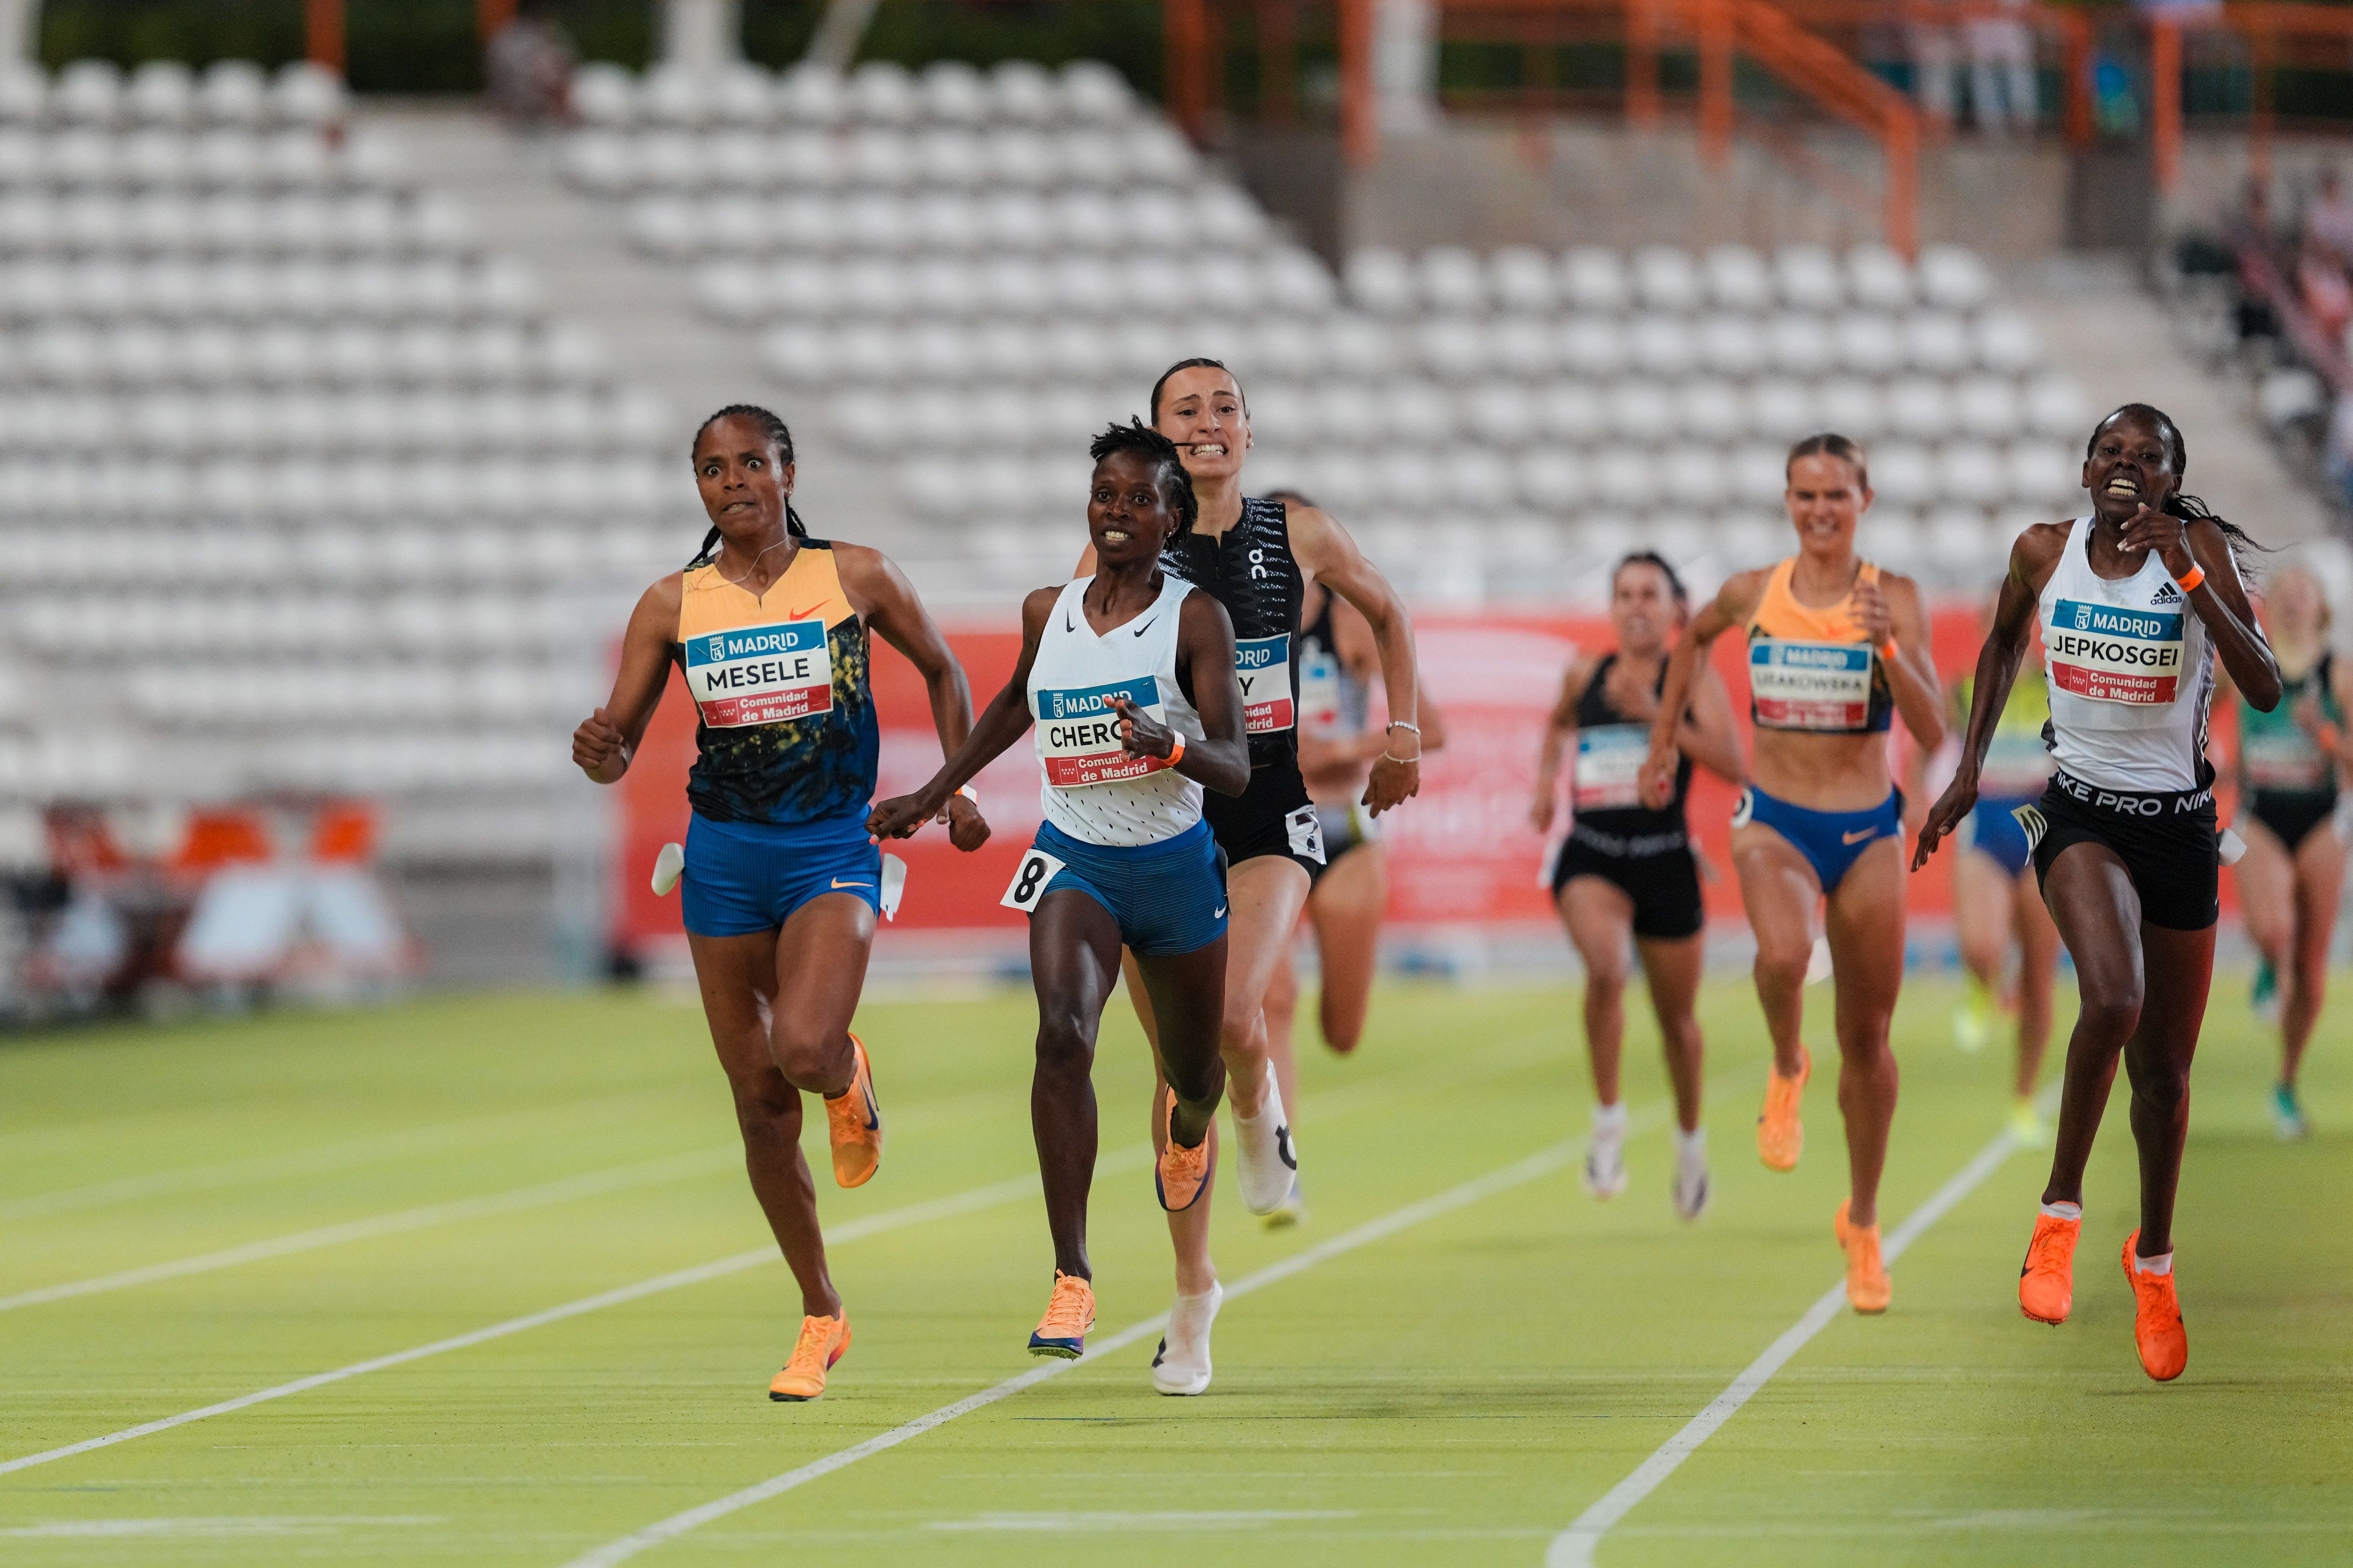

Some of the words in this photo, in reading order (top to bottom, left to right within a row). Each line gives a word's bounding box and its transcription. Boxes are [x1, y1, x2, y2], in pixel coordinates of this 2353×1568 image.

[2150, 595, 2182, 606] adidas
[2093, 613, 2161, 638] MADRID
[728, 632, 799, 655] MADRID
[2053, 635, 2178, 666] JEPKOSGEI
[1235, 649, 1270, 667] DRID
[706, 658, 810, 691] MESELE
[2090, 672, 2157, 689] Comunidad
[1238, 676, 1255, 696] Y
[2089, 686, 2105, 697] de
[2109, 687, 2155, 702] Madrid
[740, 690, 808, 708] Comunidad
[742, 711, 758, 722] de
[762, 702, 808, 720] Madrid
[1081, 771, 1098, 782] de
[1101, 762, 1148, 779] Madrid
[2095, 791, 2162, 816] PRO
[1014, 857, 1049, 903] 8
